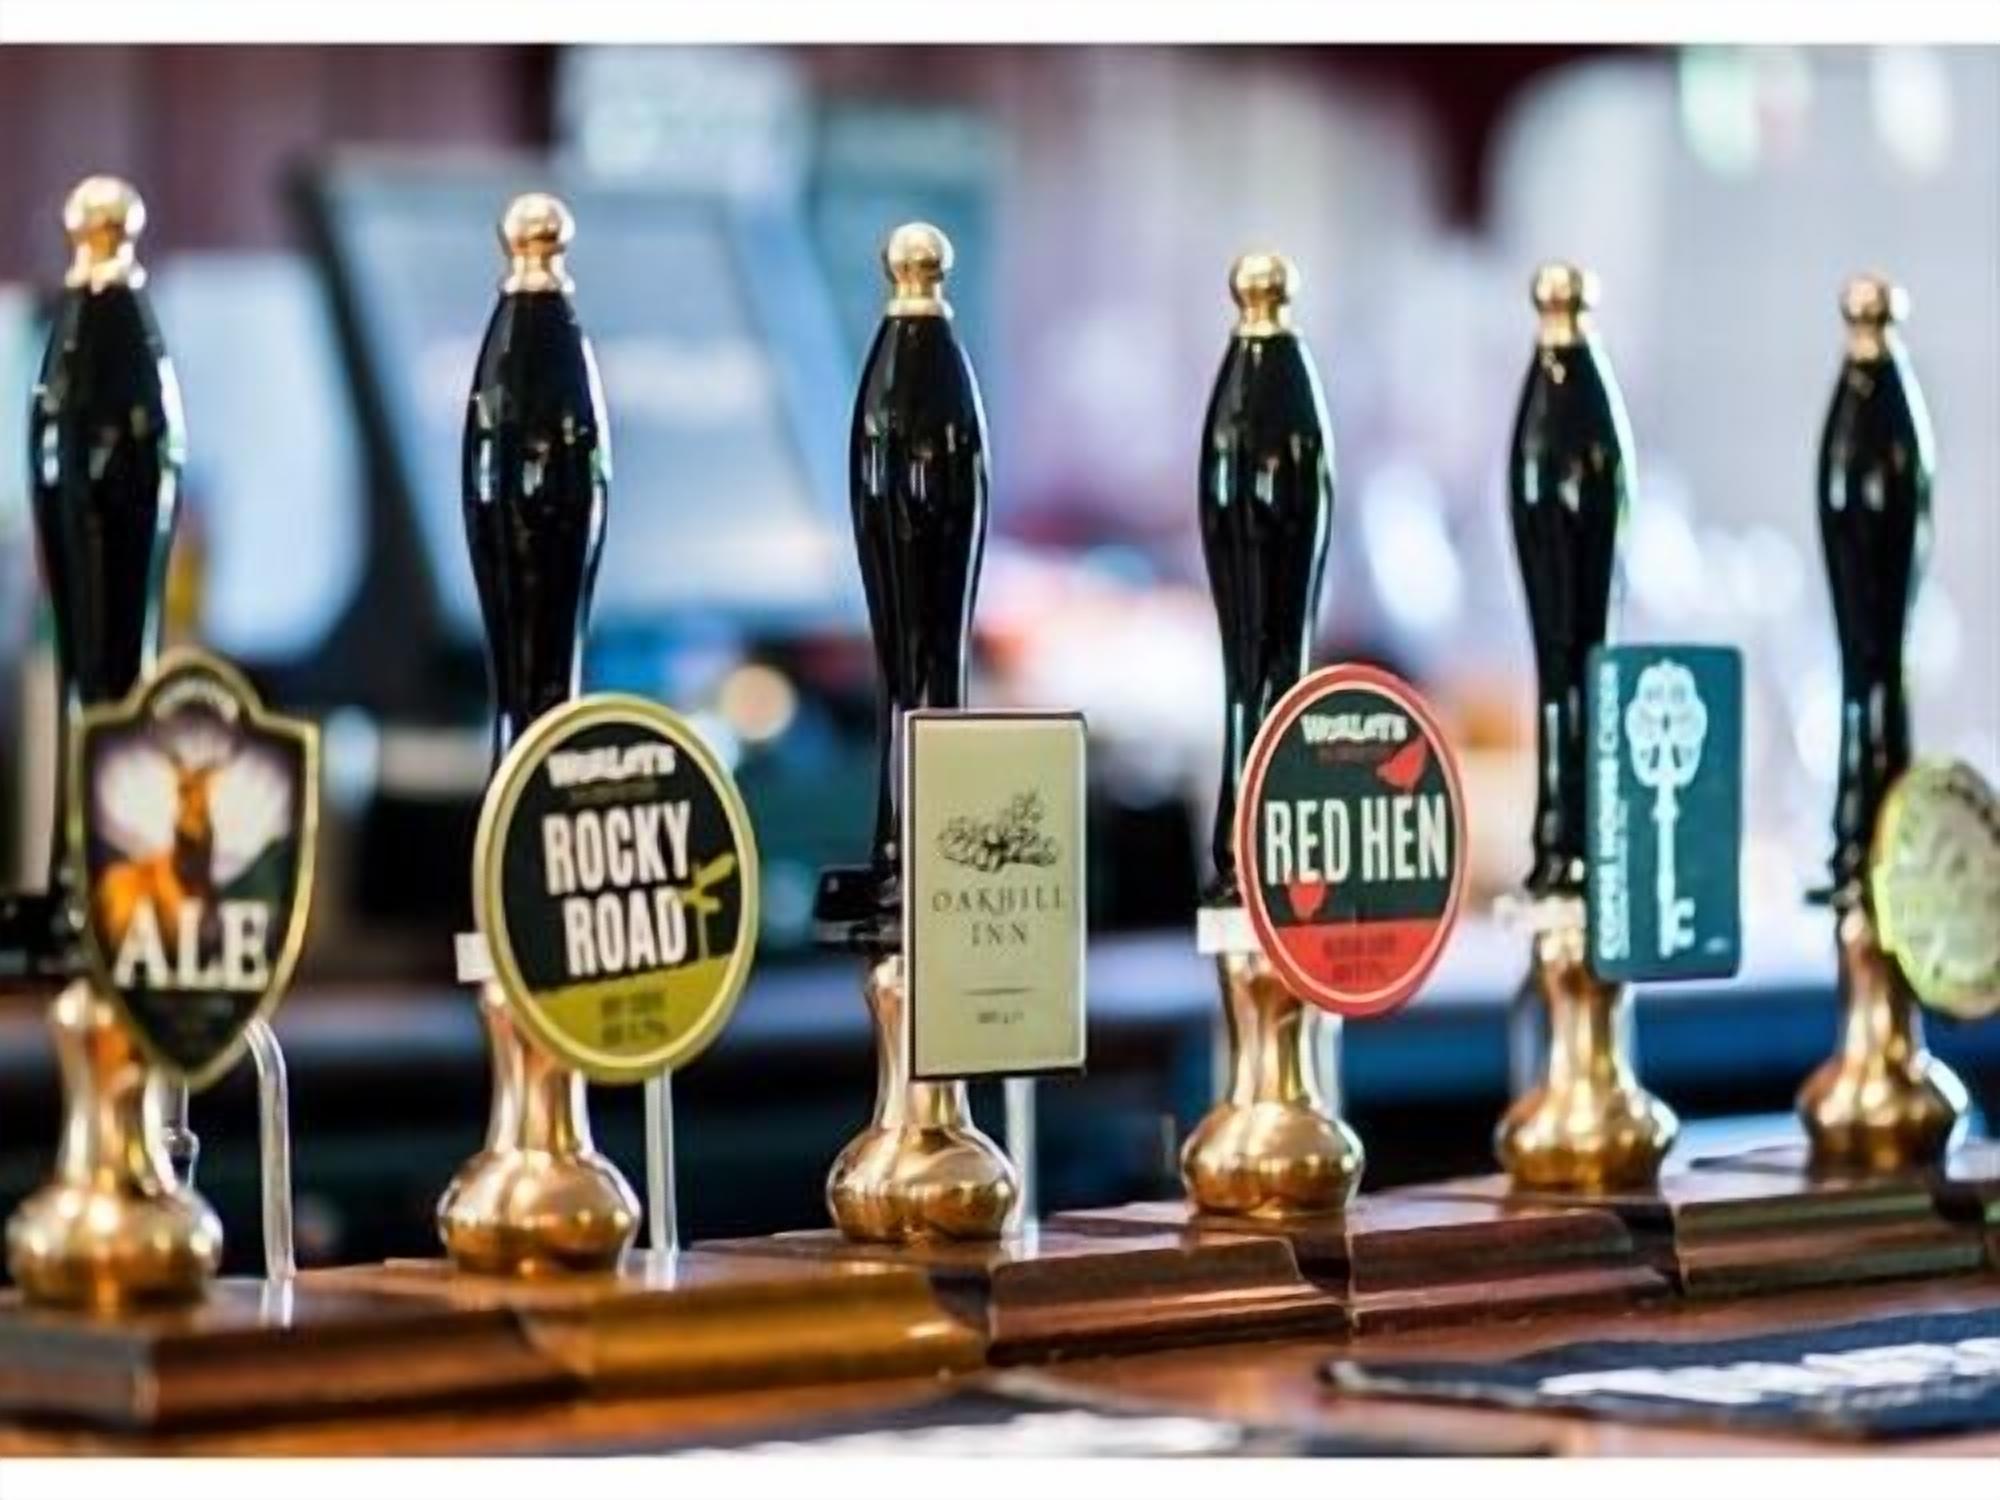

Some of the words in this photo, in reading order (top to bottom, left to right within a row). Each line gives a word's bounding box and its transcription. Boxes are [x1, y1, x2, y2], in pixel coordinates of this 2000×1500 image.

[541, 799, 691, 896] ROCKY
[1264, 798, 1348, 886] RED
[1361, 793, 1447, 882] HEN
[114, 898, 270, 990] ALE
[563, 886, 687, 977] ROAD
[972, 922, 1029, 948] INN
